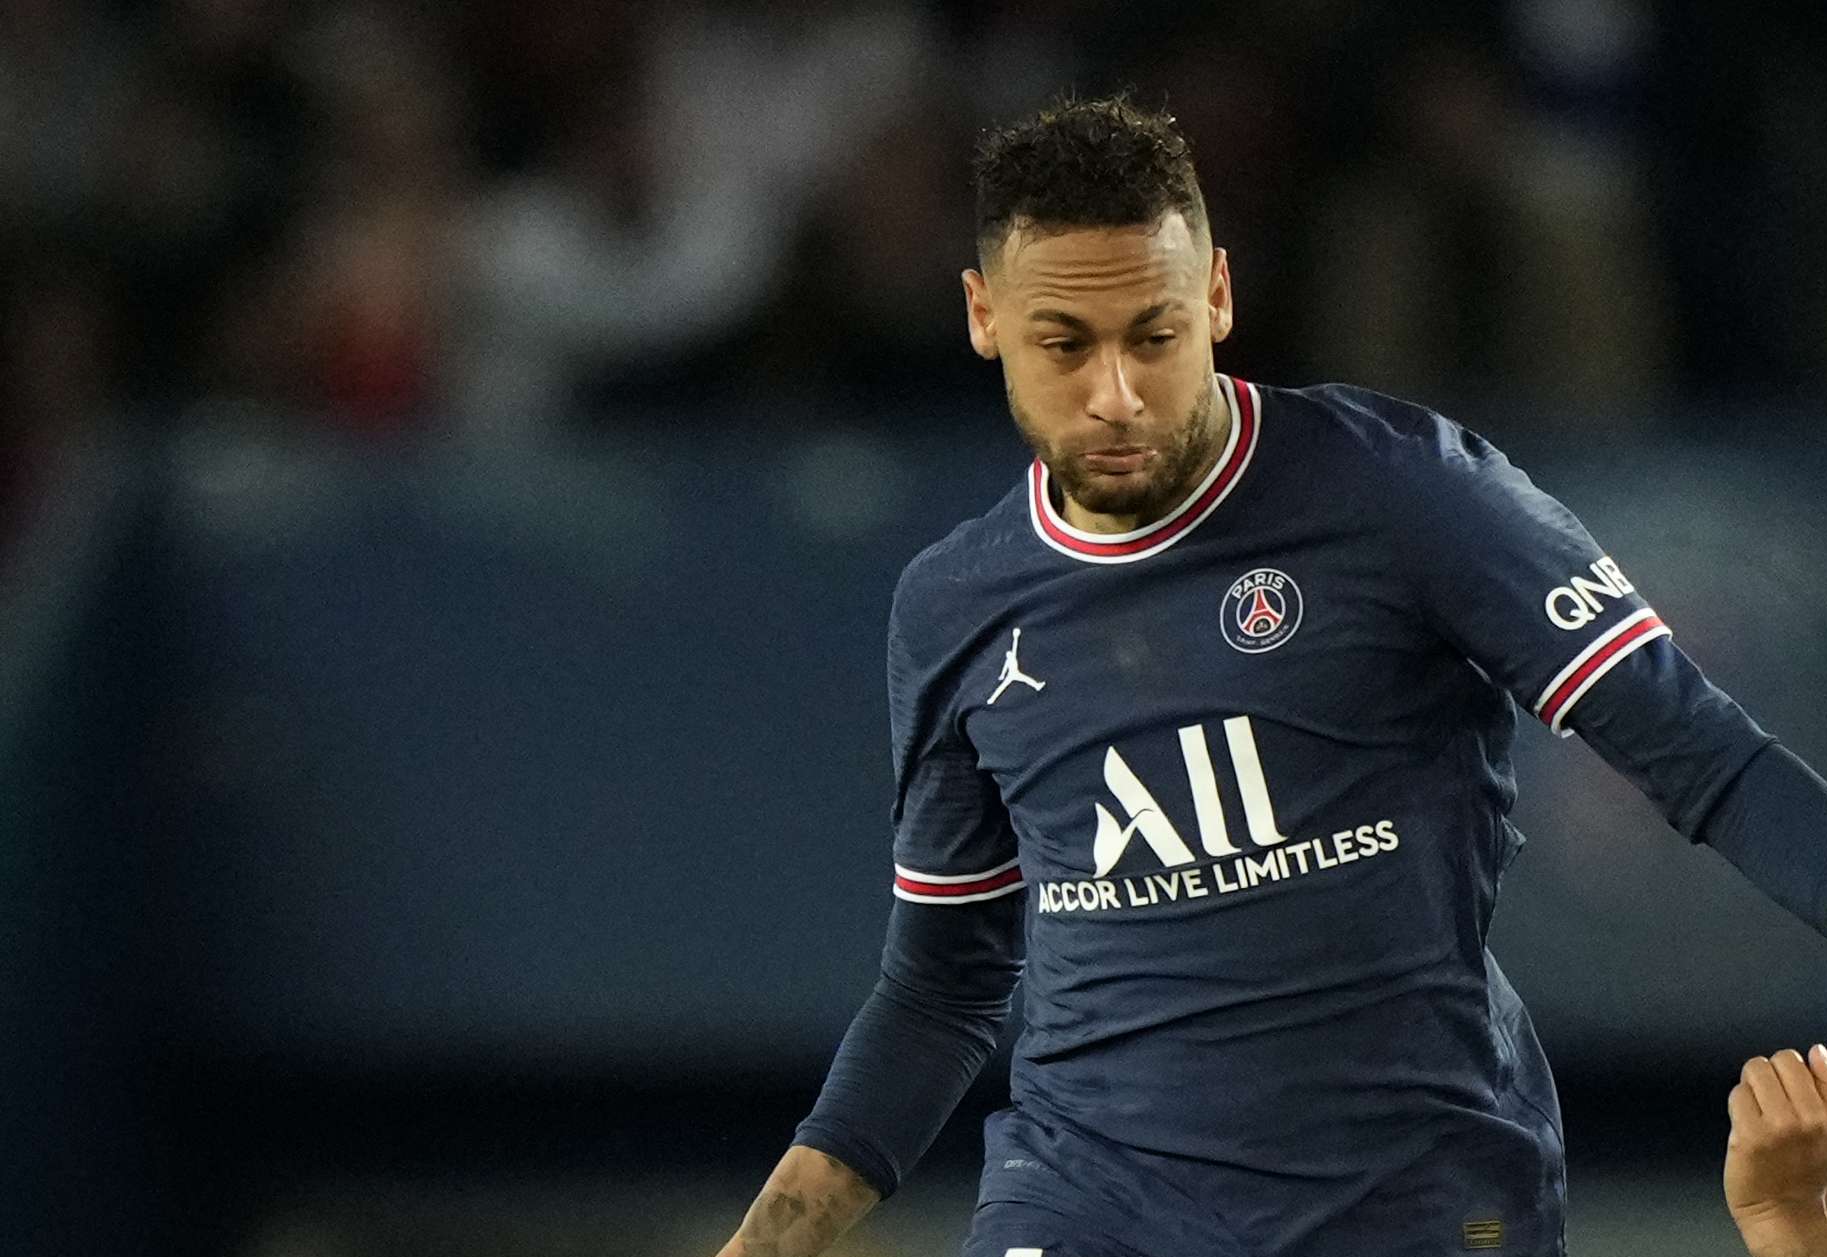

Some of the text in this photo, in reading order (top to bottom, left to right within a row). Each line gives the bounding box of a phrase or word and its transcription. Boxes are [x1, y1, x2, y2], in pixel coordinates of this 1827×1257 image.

[1231, 573, 1286, 599] PARIS
[1545, 556, 1635, 631] QNB
[1038, 820, 1400, 914] ACCOR LIVE LIMITLESS
